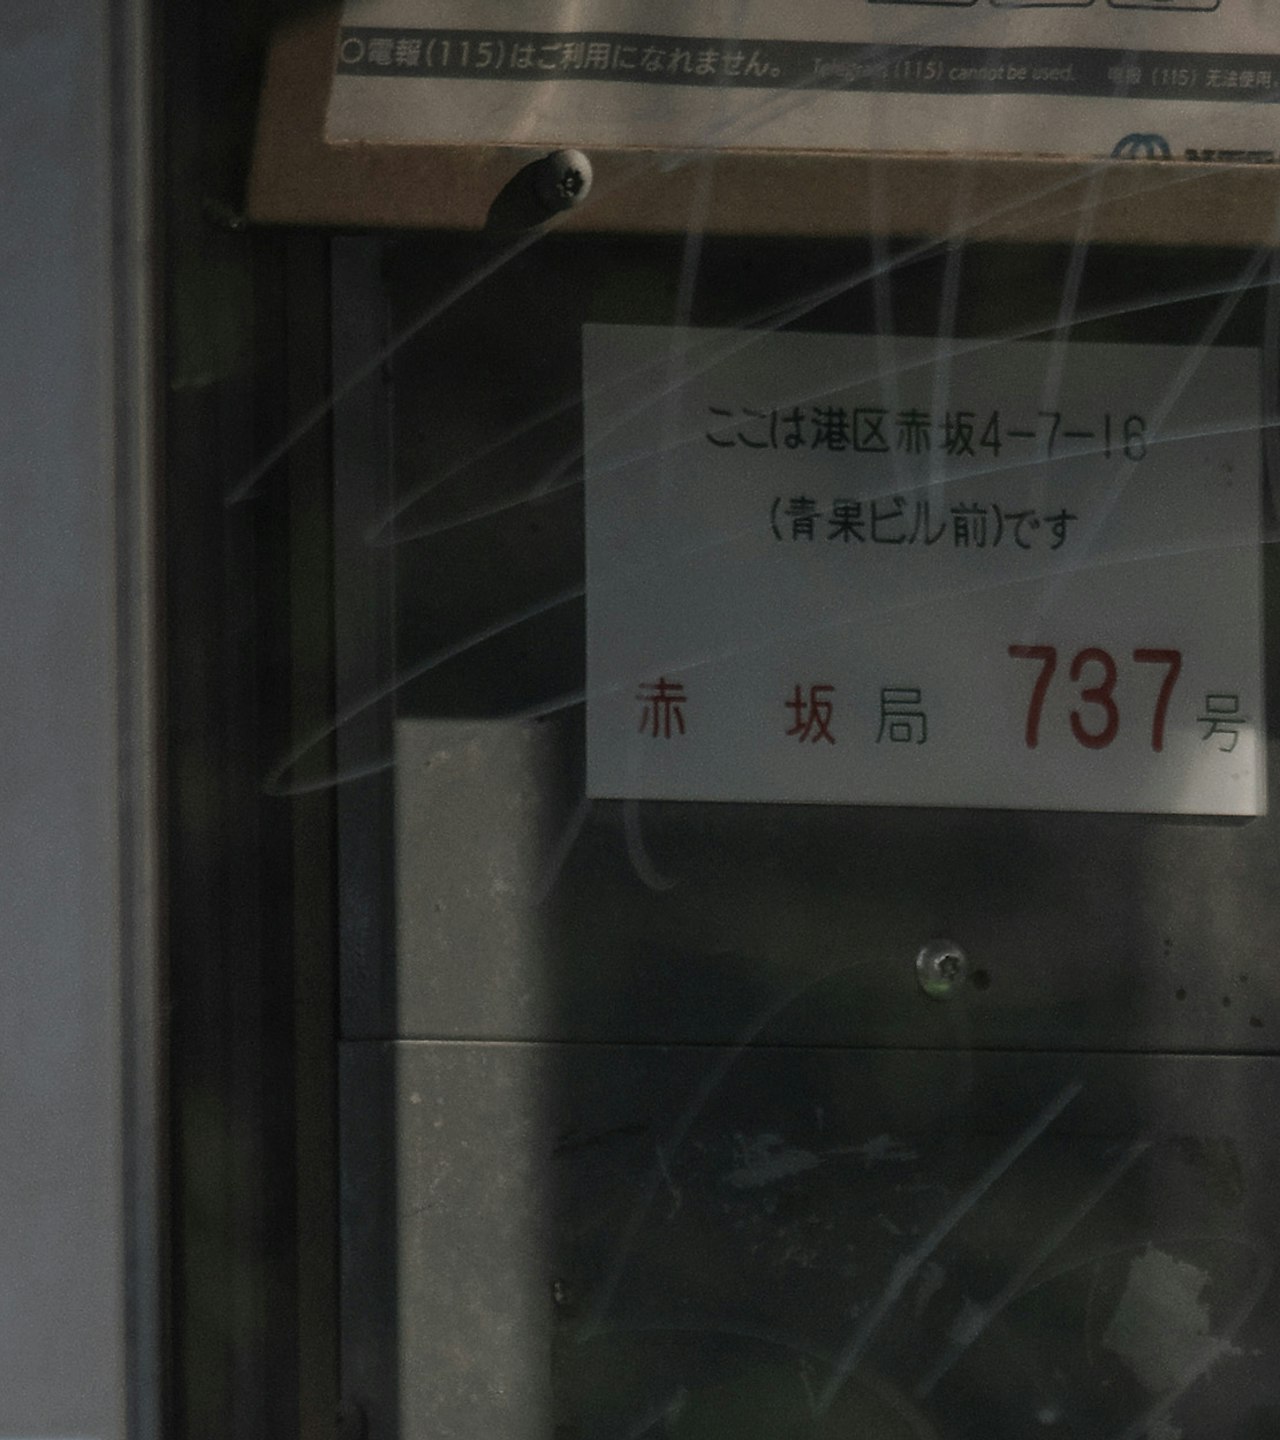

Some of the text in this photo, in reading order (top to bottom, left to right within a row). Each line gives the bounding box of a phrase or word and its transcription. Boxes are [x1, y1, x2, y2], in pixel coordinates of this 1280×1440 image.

[894, 61, 944, 82] (115)
[948, 63, 1003, 82] cannot
[1007, 64, 1028, 82] be
[1031, 64, 1076, 84] used.
[1151, 67, 1198, 88] (115)
[770, 496, 1079, 552] (青果ビル前)です
